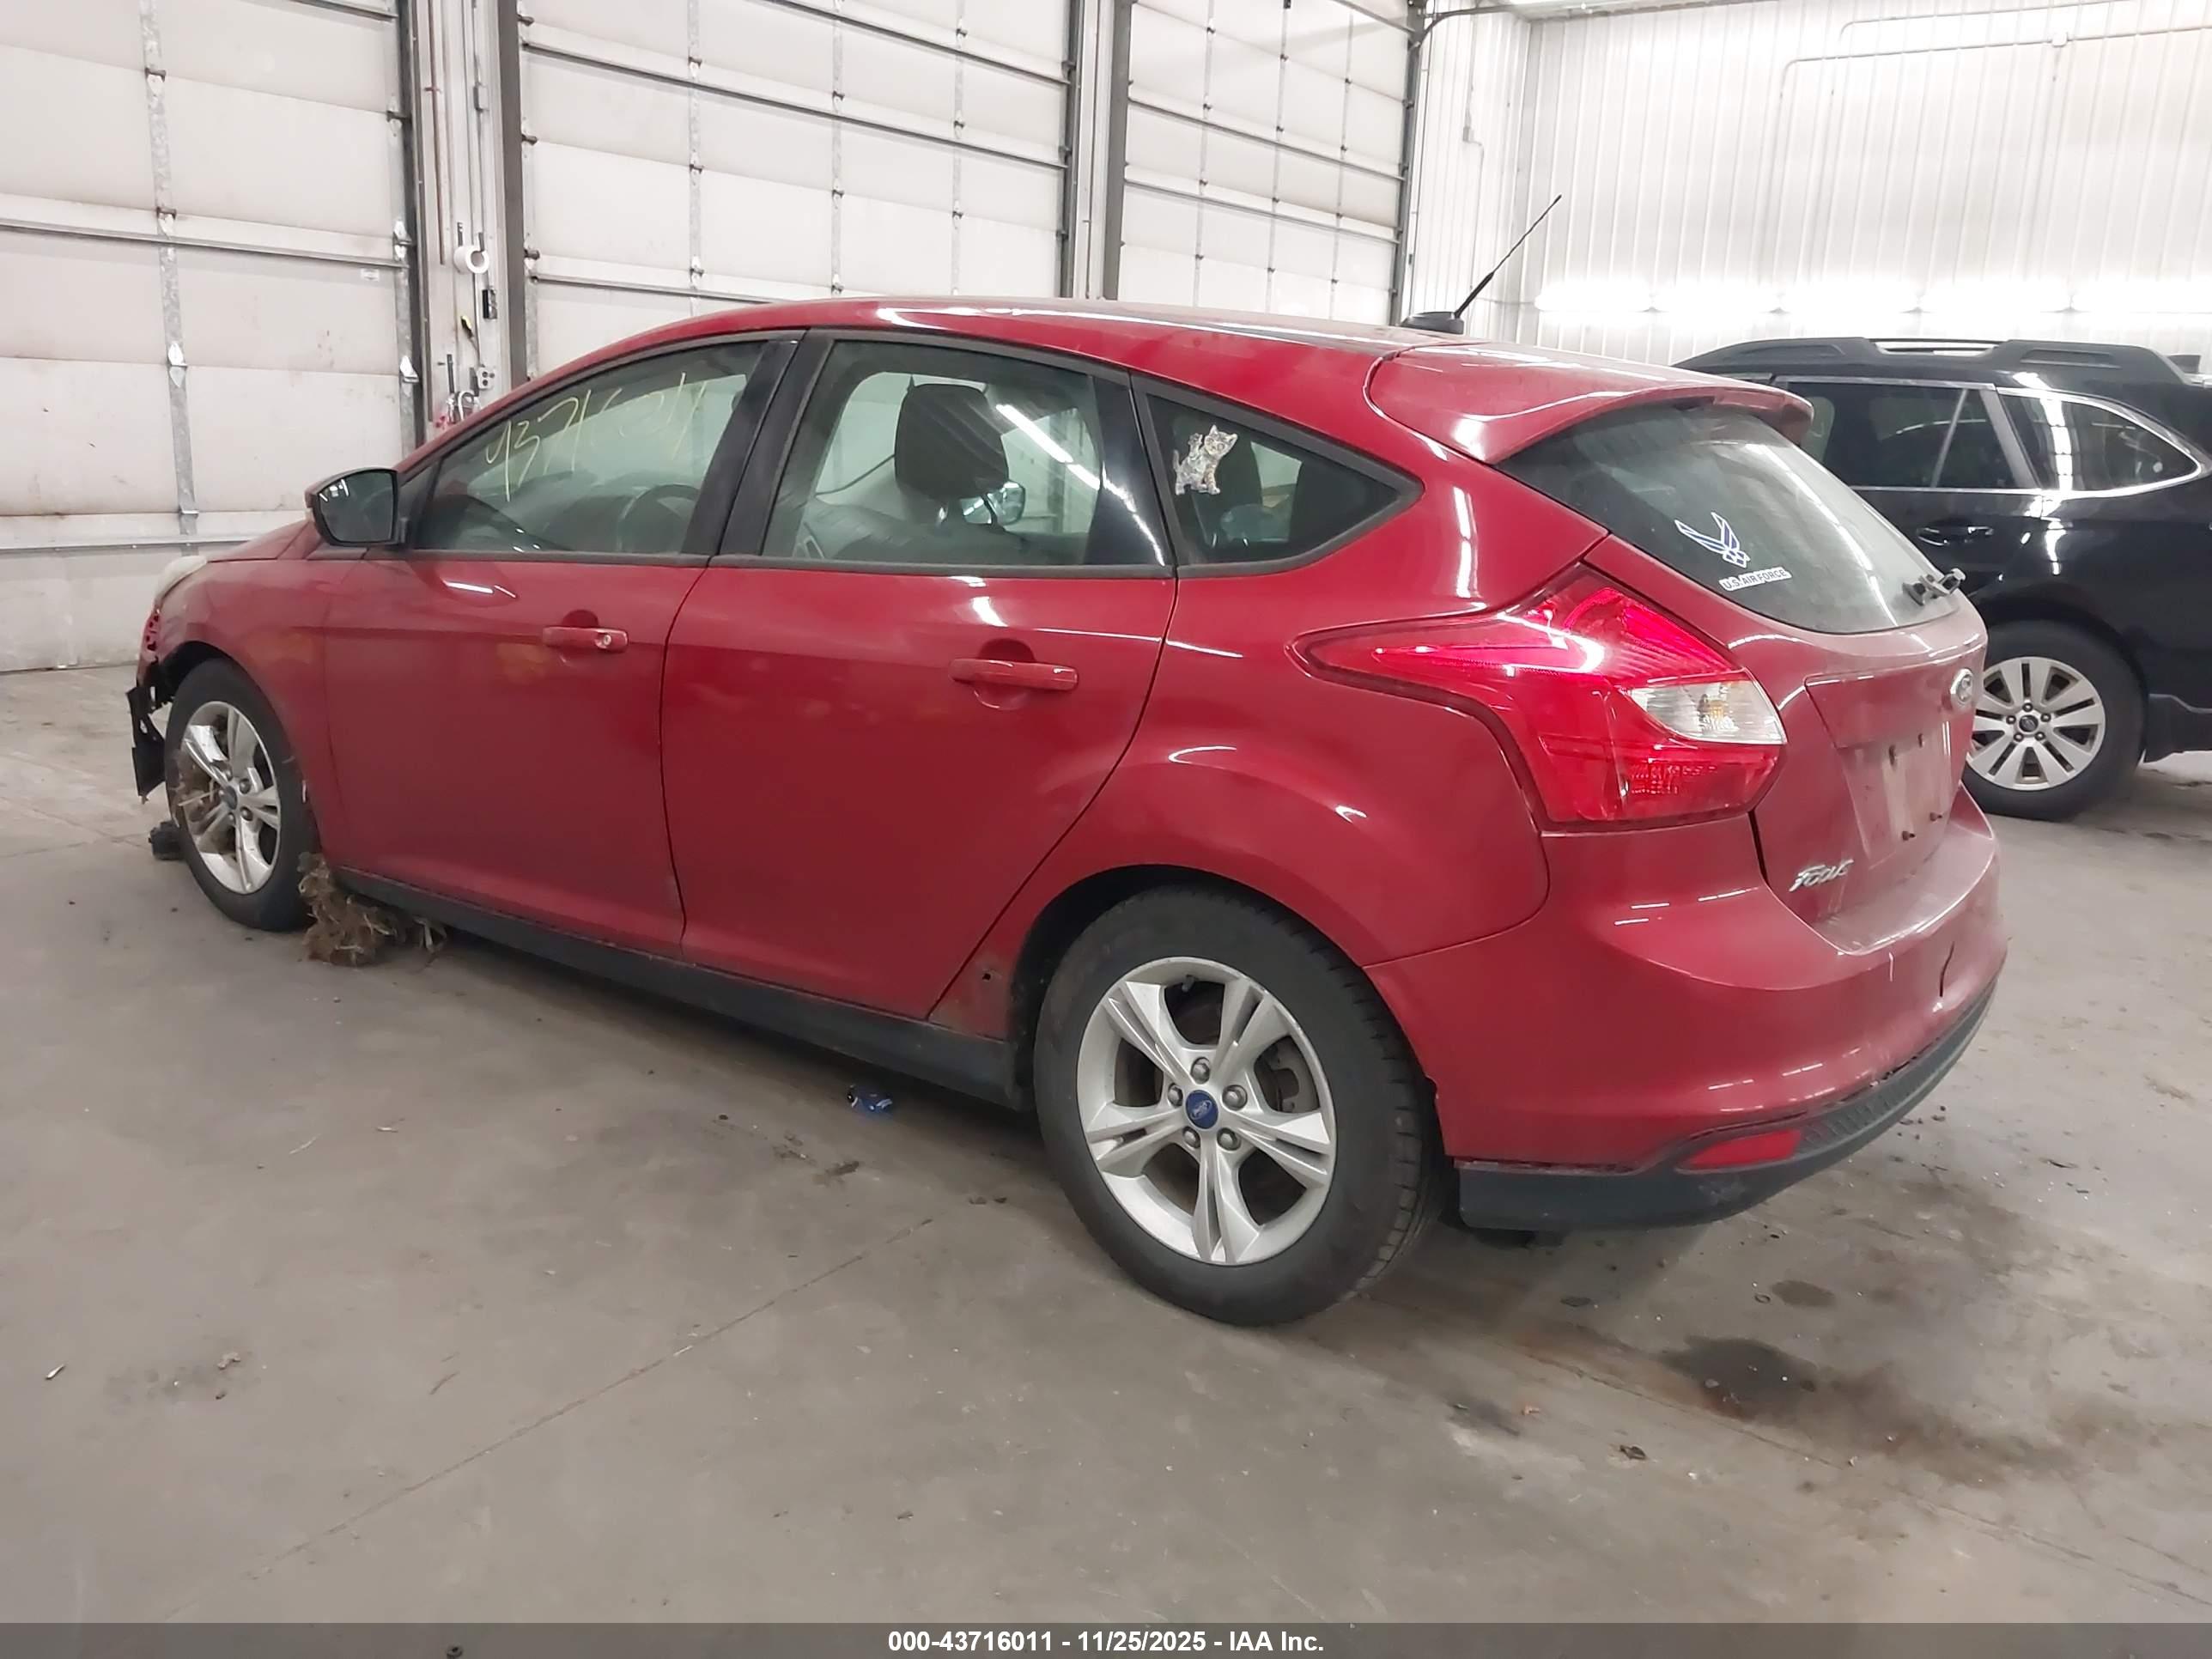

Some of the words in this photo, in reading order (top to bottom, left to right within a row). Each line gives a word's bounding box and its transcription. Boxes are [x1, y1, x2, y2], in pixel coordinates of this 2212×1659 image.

[1723, 579, 1742, 589] U.S.
[1741, 574, 1759, 586] AIR
[1757, 568, 1787, 582] FORCE
